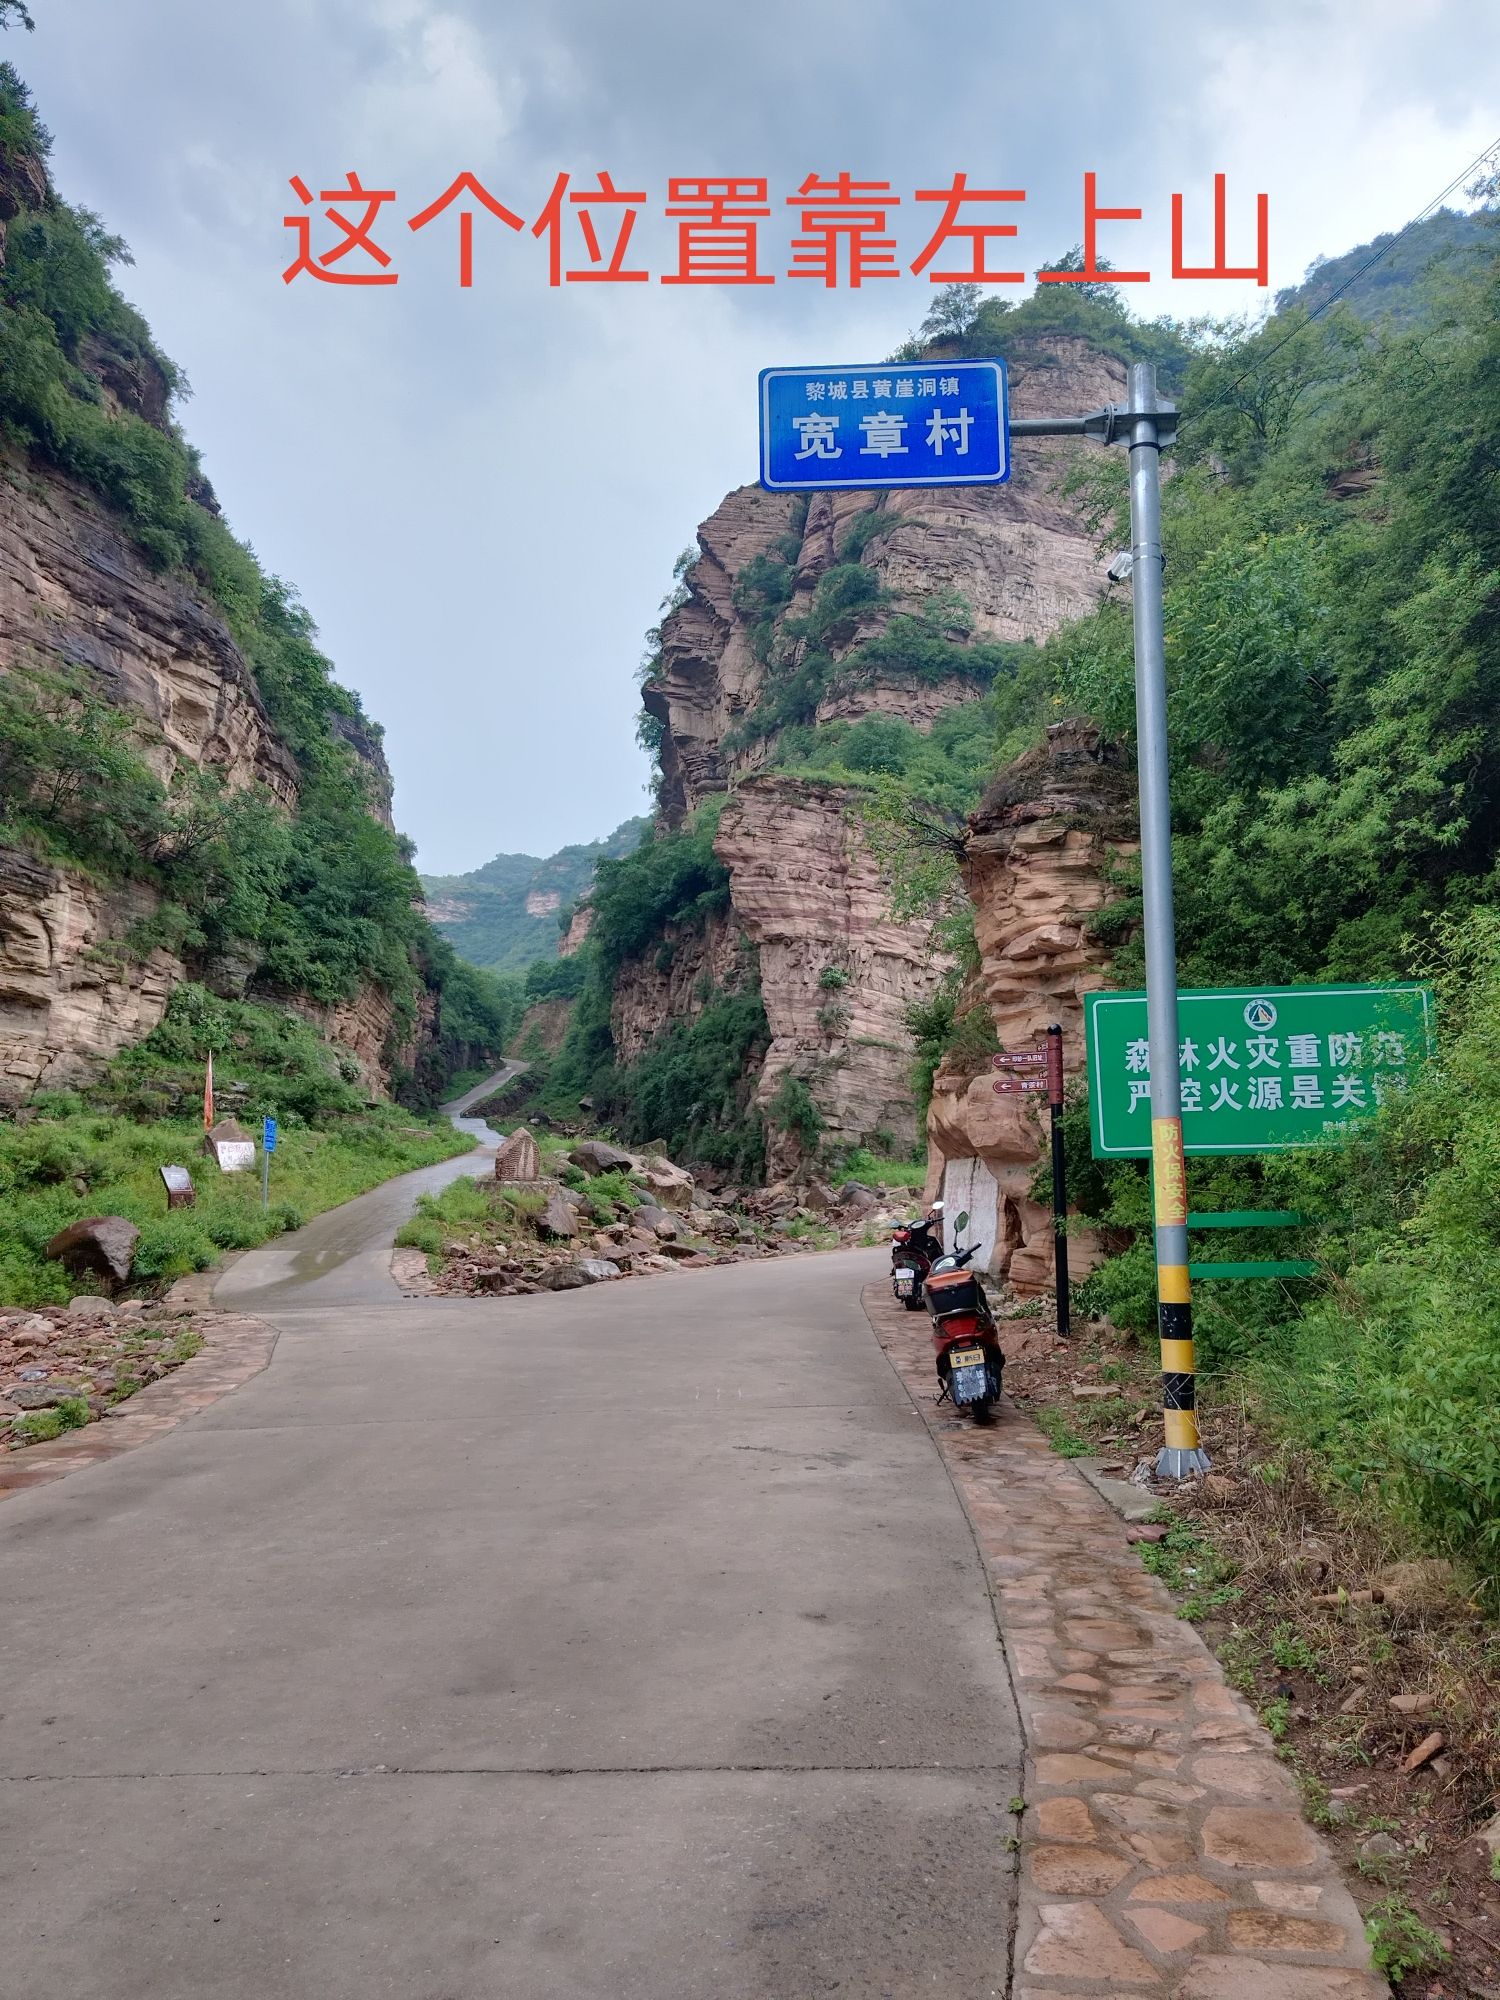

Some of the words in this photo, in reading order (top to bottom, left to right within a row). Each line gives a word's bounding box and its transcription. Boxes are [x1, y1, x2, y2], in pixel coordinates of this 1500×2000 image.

[805, 377, 960, 401] 黎城县黄崖洞镇
[792, 407, 975, 460] 宽章村
[1159, 1123, 1186, 1219] 防火保安全
